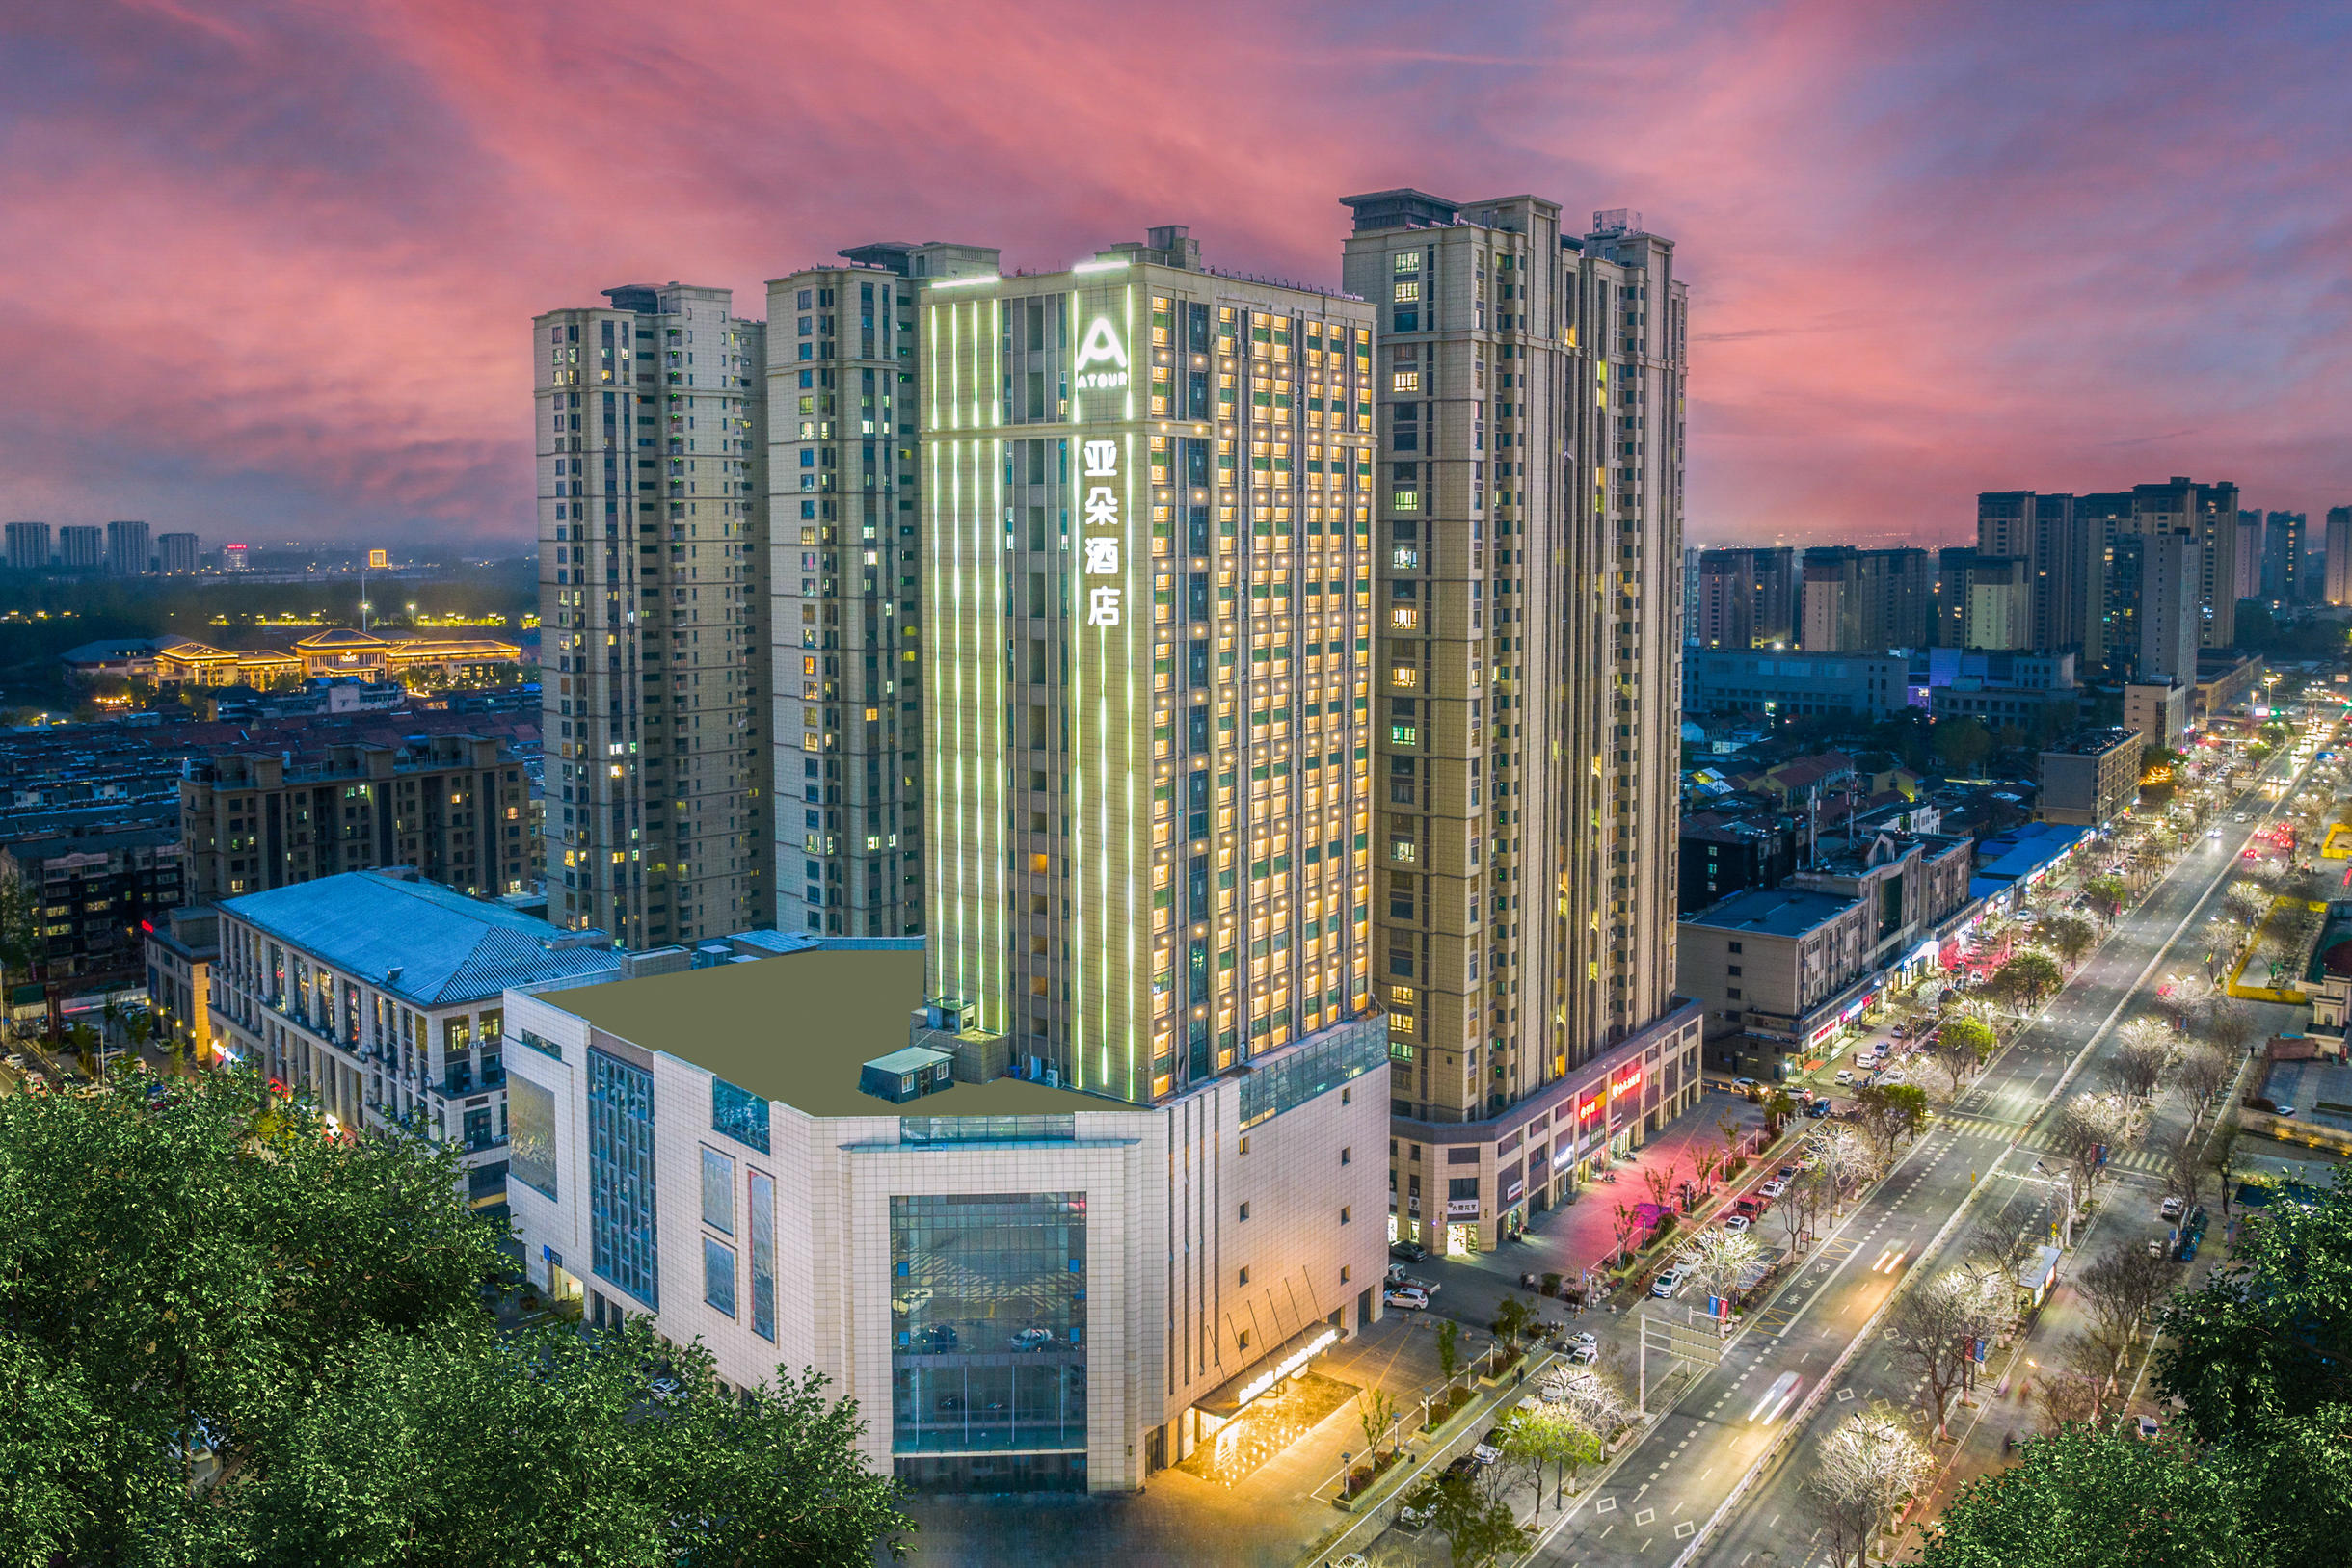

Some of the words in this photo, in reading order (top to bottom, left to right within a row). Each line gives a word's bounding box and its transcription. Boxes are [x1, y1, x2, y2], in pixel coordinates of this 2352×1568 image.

[1078, 372, 1127, 388] ATOUR
[1083, 439, 1121, 626] 亚朵酒店
